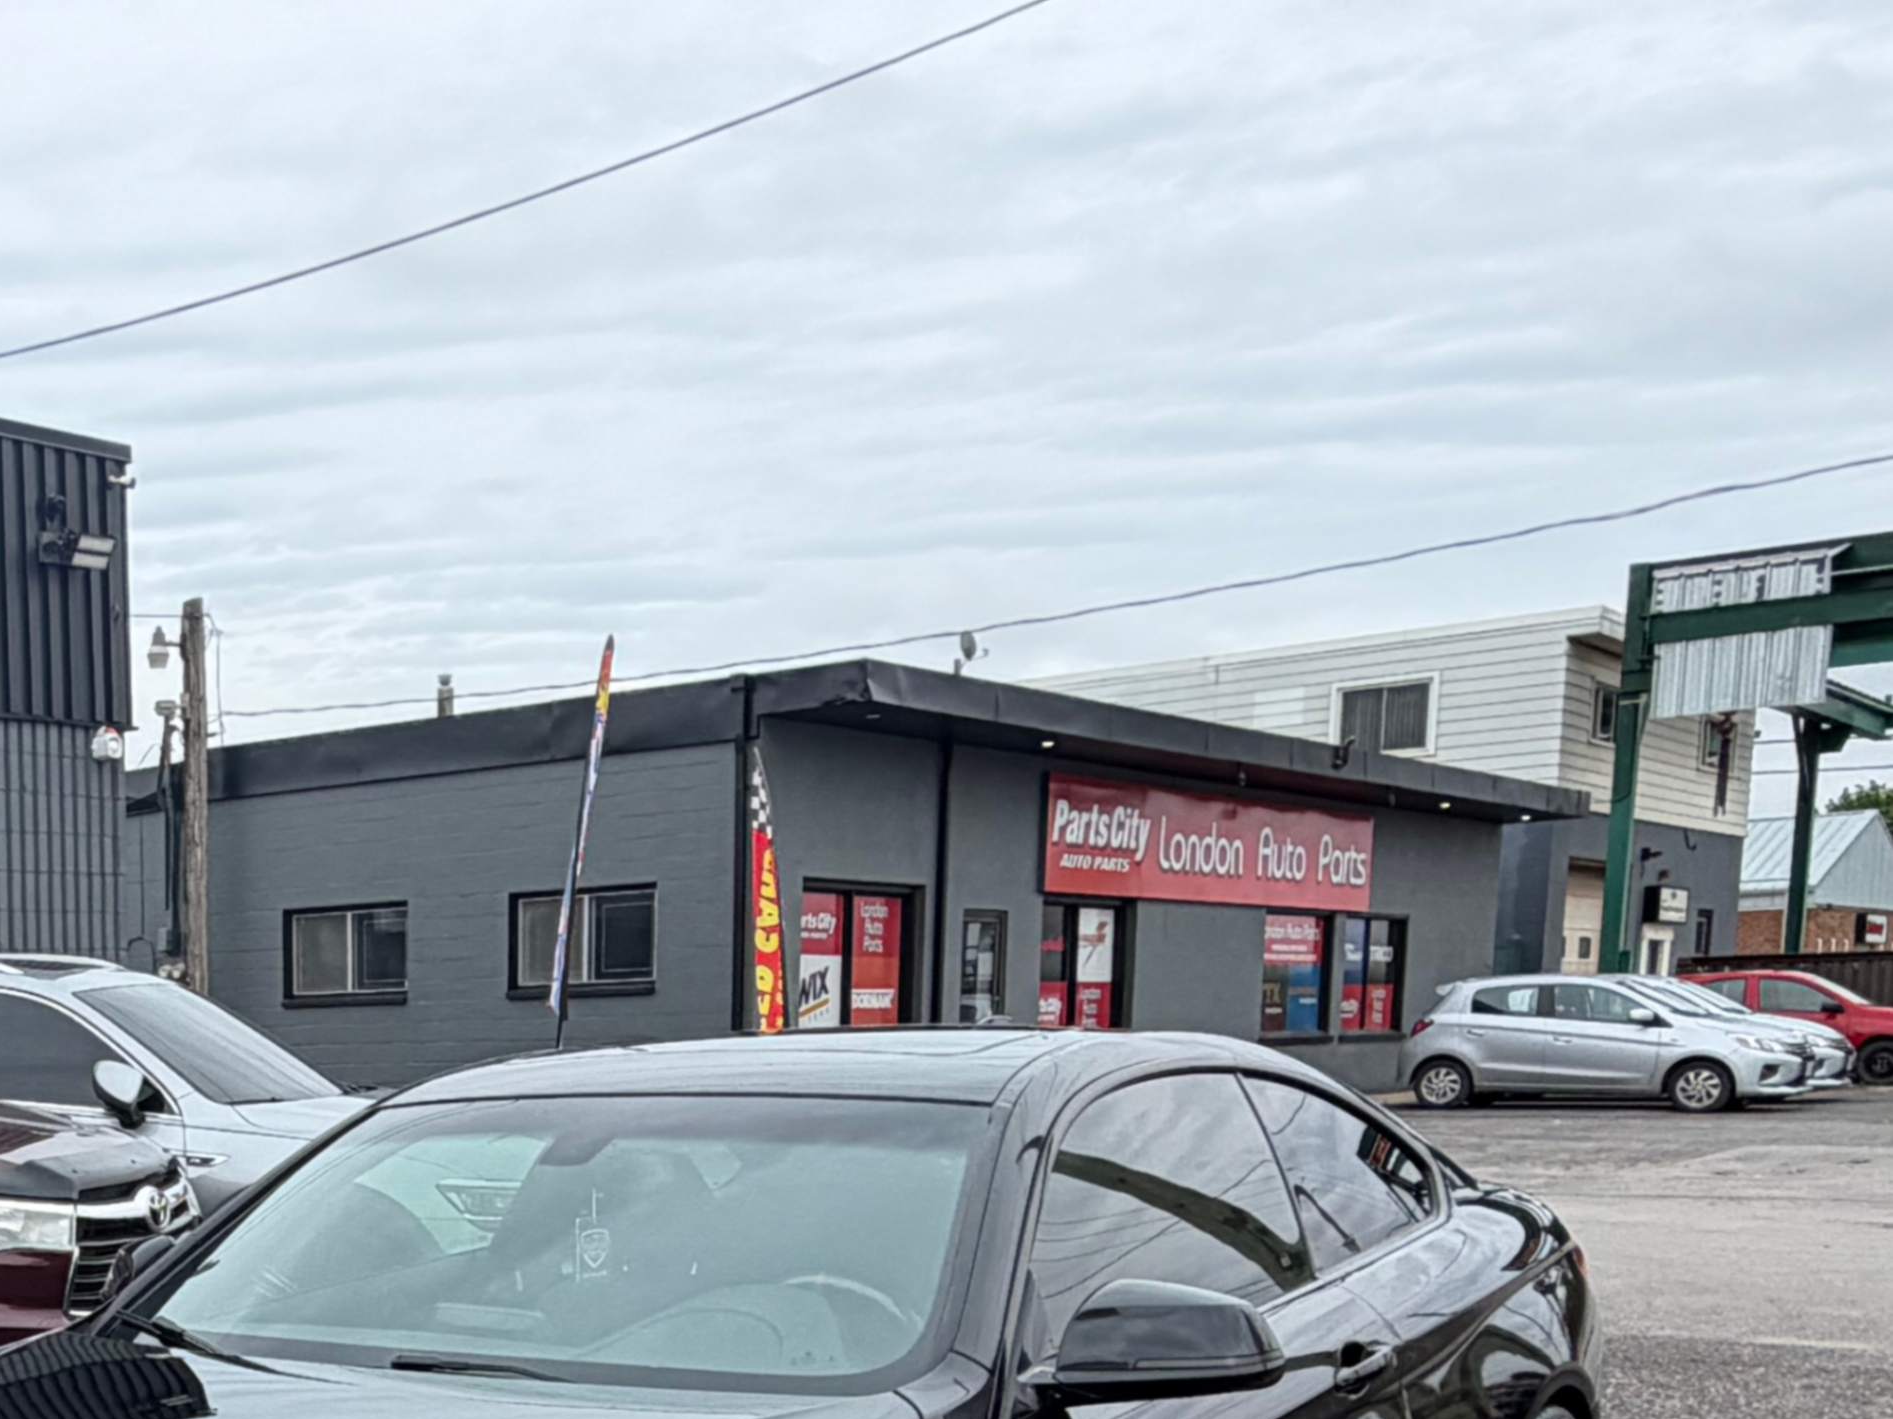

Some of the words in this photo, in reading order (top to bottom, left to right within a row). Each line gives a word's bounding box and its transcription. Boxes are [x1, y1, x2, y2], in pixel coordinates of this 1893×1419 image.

[1060, 853, 1091, 870] AUTO
[1093, 855, 1130, 873] PARTS
[1159, 815, 1244, 875] London
[1257, 827, 1306, 880] Auto
[1317, 834, 1367, 886] Parts
